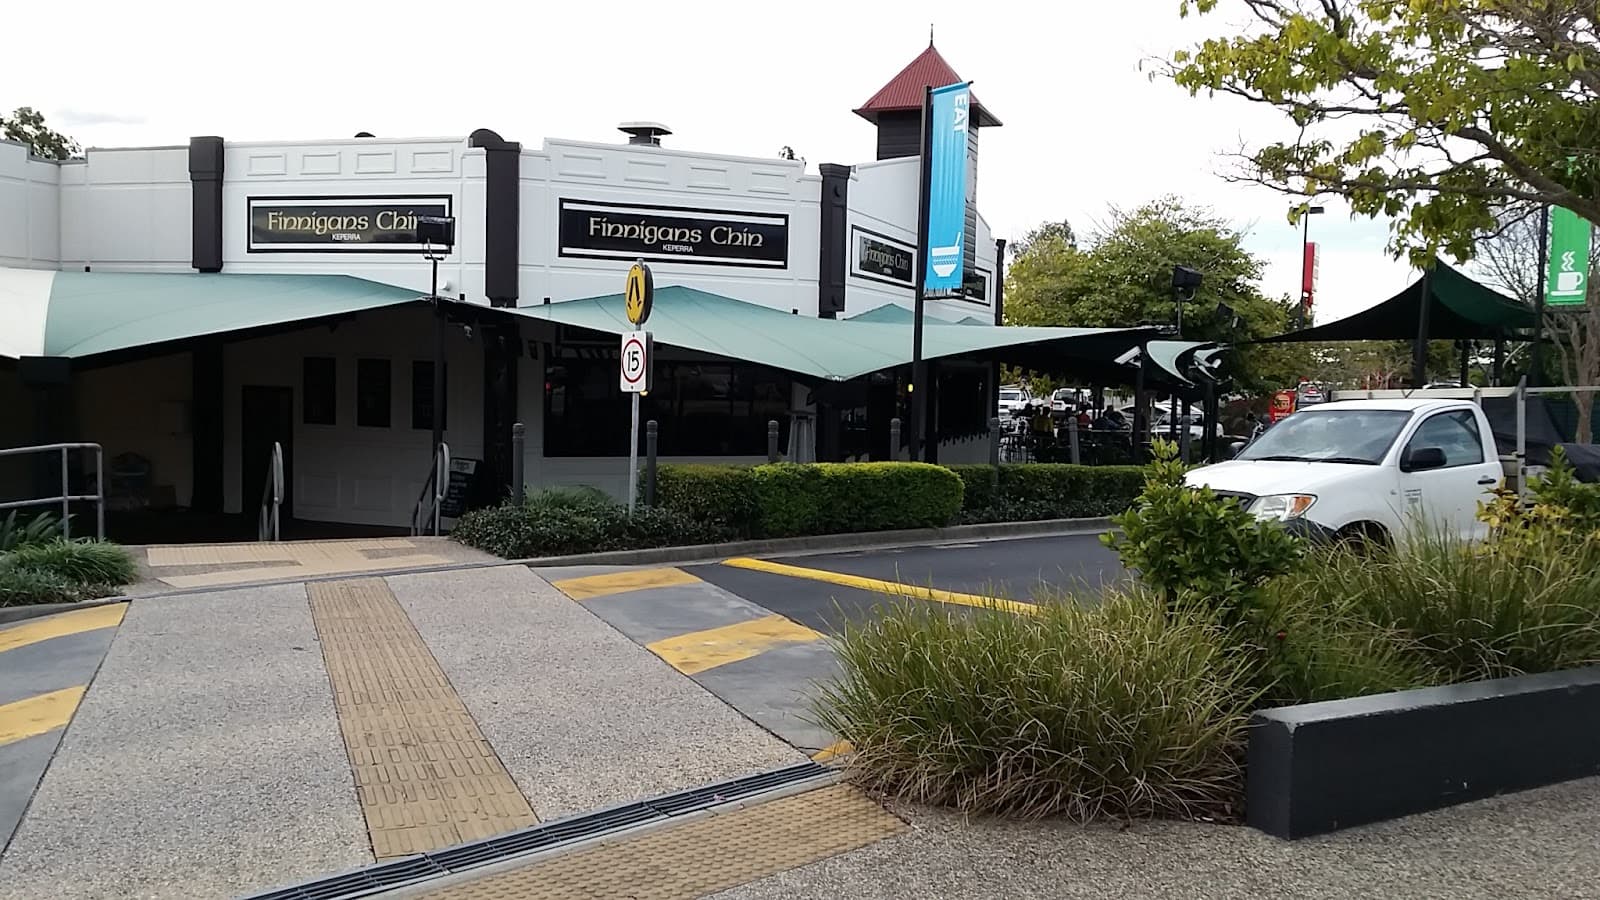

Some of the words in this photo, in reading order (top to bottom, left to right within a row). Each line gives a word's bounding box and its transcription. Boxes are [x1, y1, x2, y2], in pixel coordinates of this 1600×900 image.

[953, 93, 967, 134] EAT
[268, 210, 369, 235] Finnigans
[588, 216, 703, 245] Finnigans
[709, 225, 764, 247] Chin
[331, 233, 362, 241] KEPERRA
[661, 243, 695, 253] KEPERRA
[627, 350, 640, 372] 15
